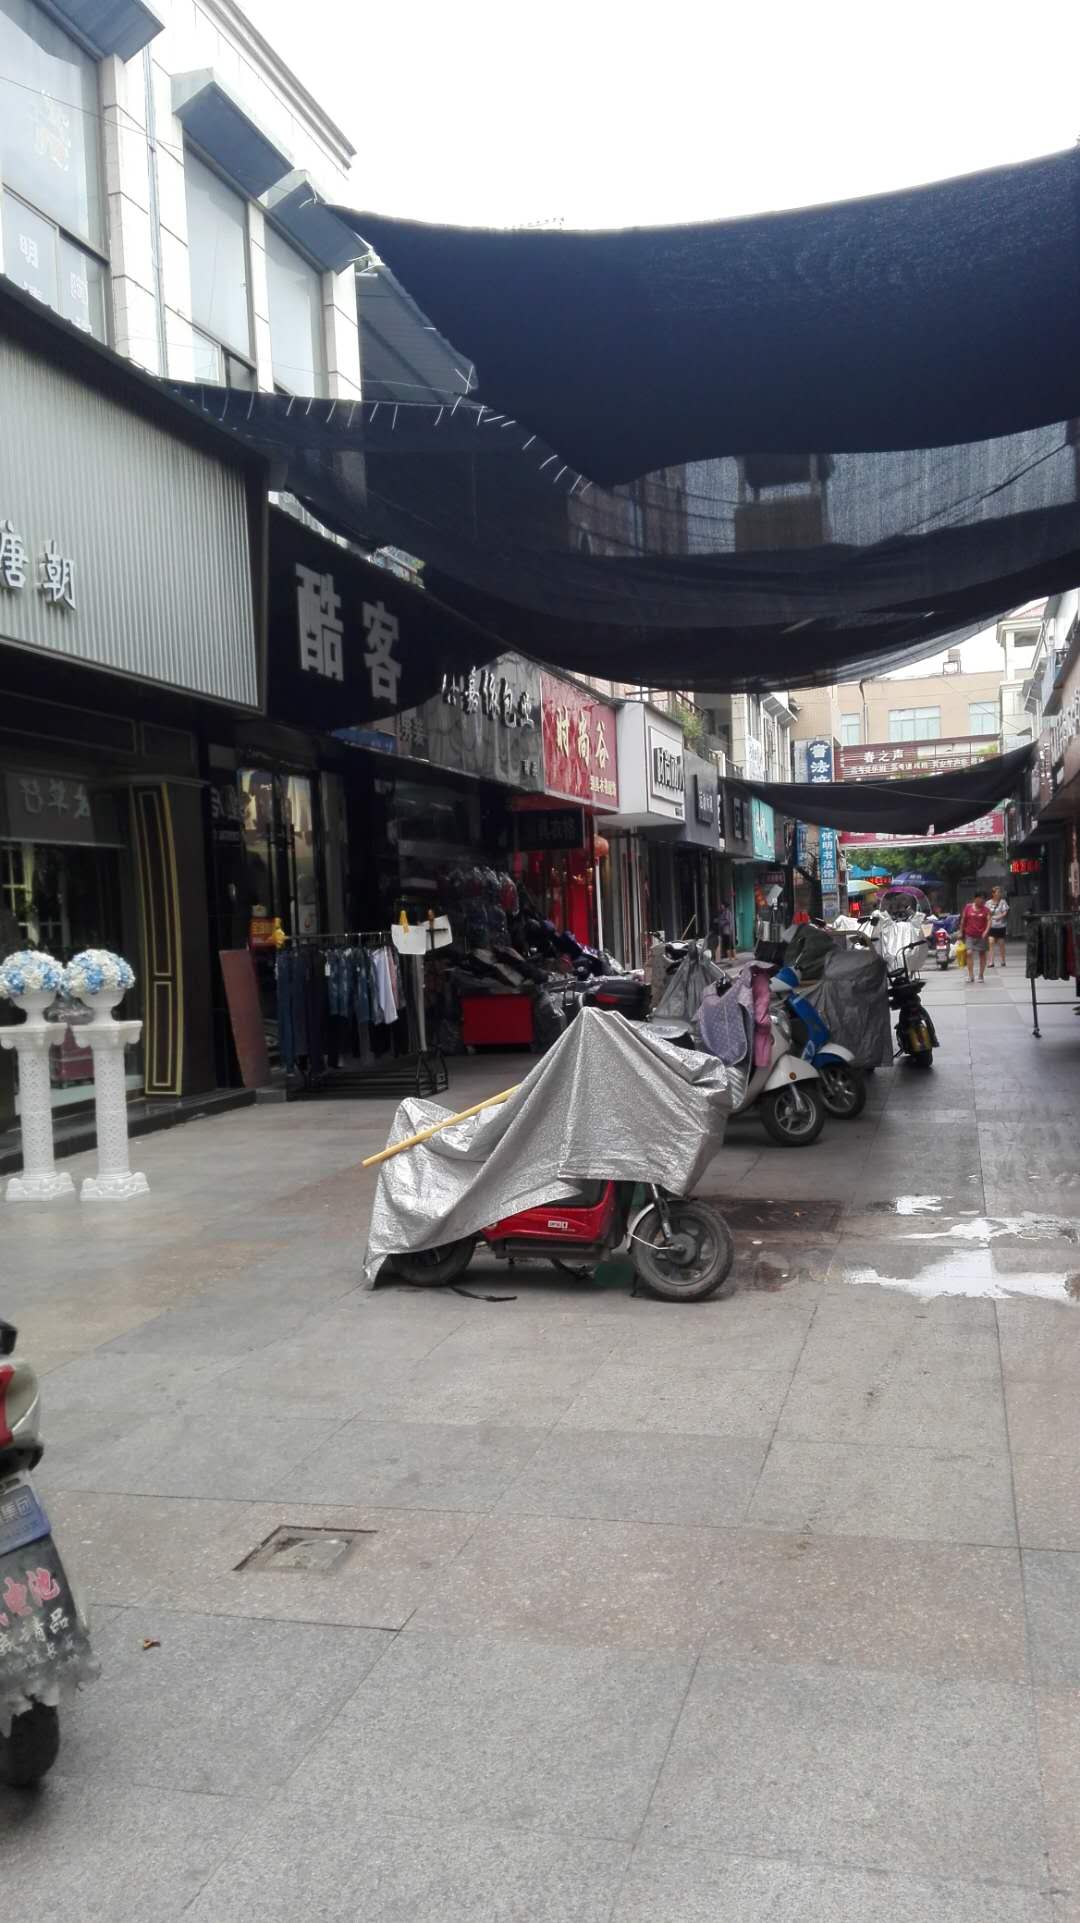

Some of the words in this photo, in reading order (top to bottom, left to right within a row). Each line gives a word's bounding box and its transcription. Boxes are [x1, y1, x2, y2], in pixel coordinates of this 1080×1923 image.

[0, 519, 76, 610] 唐朝
[294, 564, 403, 705] 酷客
[0, 1495, 32, 1523] 集团
[0, 1567, 61, 1627] 电池
